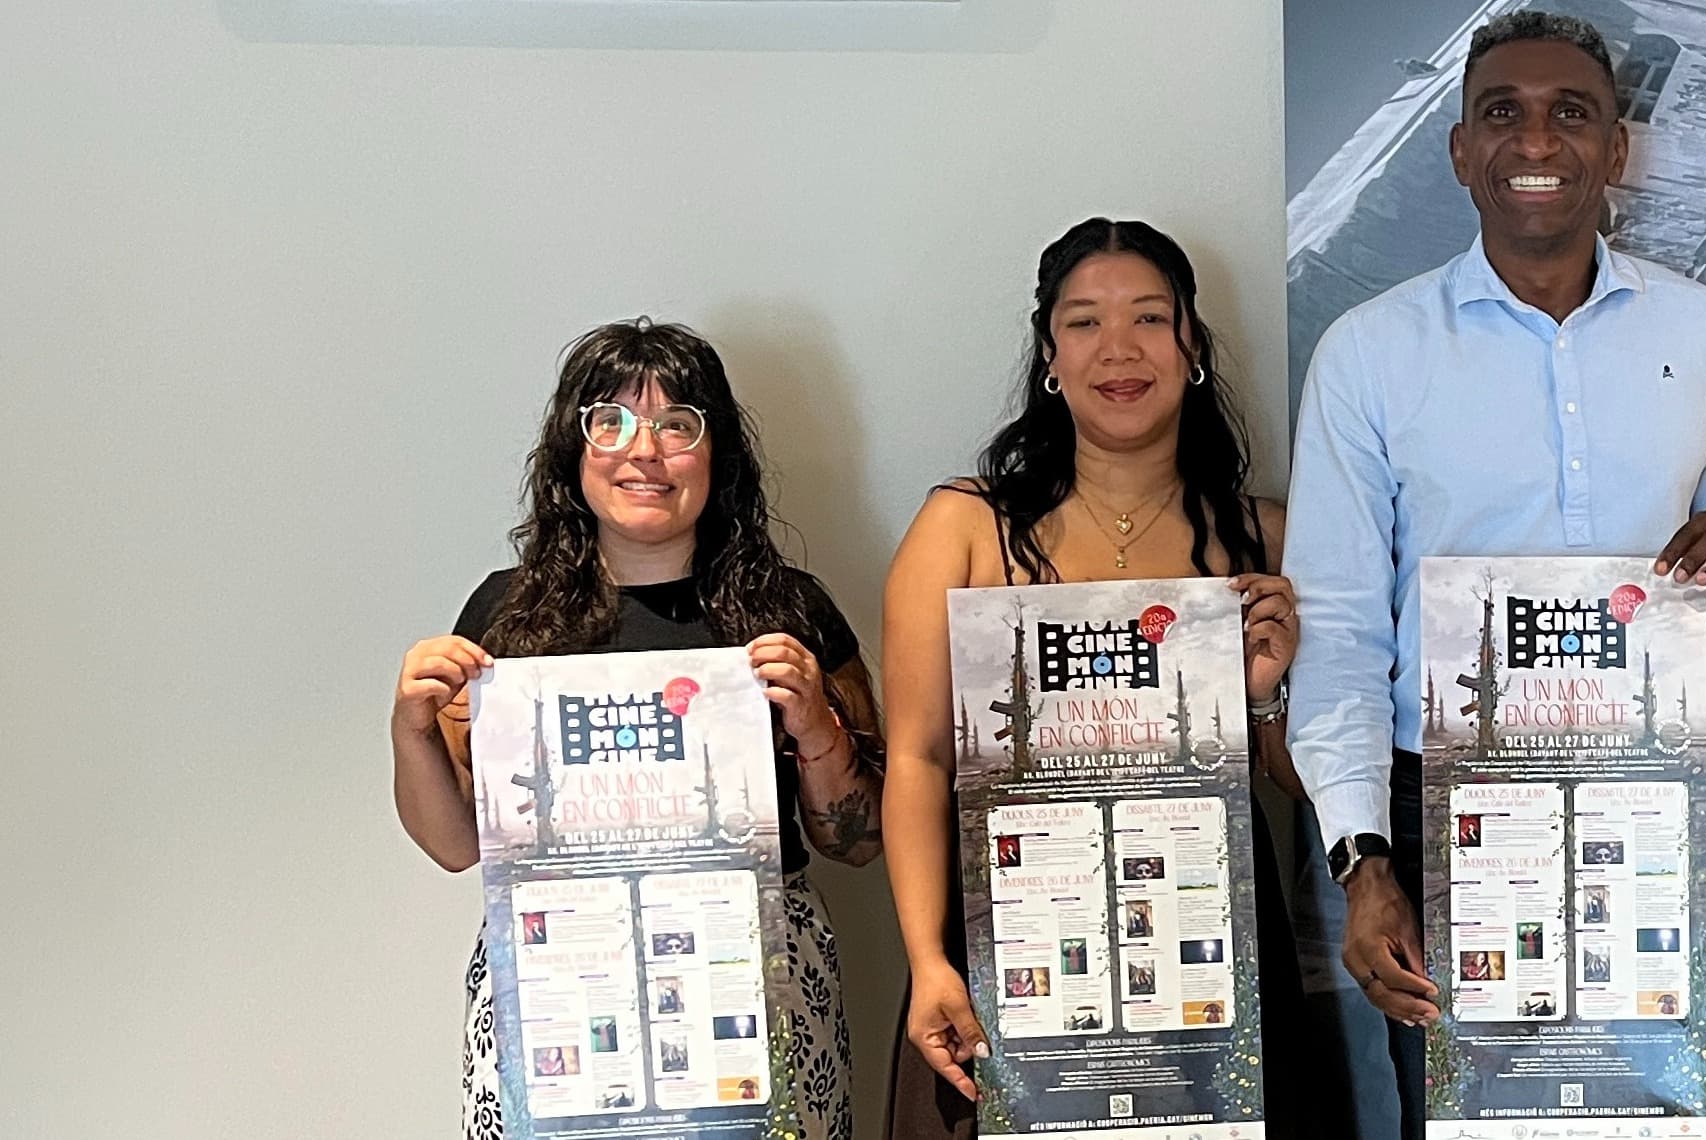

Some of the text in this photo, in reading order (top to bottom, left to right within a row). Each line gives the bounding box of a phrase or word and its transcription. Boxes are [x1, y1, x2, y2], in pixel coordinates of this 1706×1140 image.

[1536, 612, 1600, 631] CINE
[1067, 633, 1132, 654] CINE
[1536, 631, 1601, 653] MÓN
[1067, 651, 1133, 675] MÓN
[1523, 675, 1603, 700] UN MÓN
[589, 705, 656, 727] CINE
[1056, 695, 1137, 722] UN MÓN
[1506, 704, 1629, 726] EN CONFLICTE
[590, 724, 658, 749] MÓN
[1040, 722, 1164, 748] EN CONFLICTE
[1505, 734, 1629, 748] DEL 25 AL 27 DE JUNY
[1041, 752, 1166, 769] DEL 25 AL 27 DE JUNY
[580, 774, 608, 796] UN
[563, 800, 586, 823] EN
[564, 832, 587, 844] DEL
[590, 830, 606, 843] 25
[607, 830, 623, 842] AL
[626, 828, 641, 841] 27
